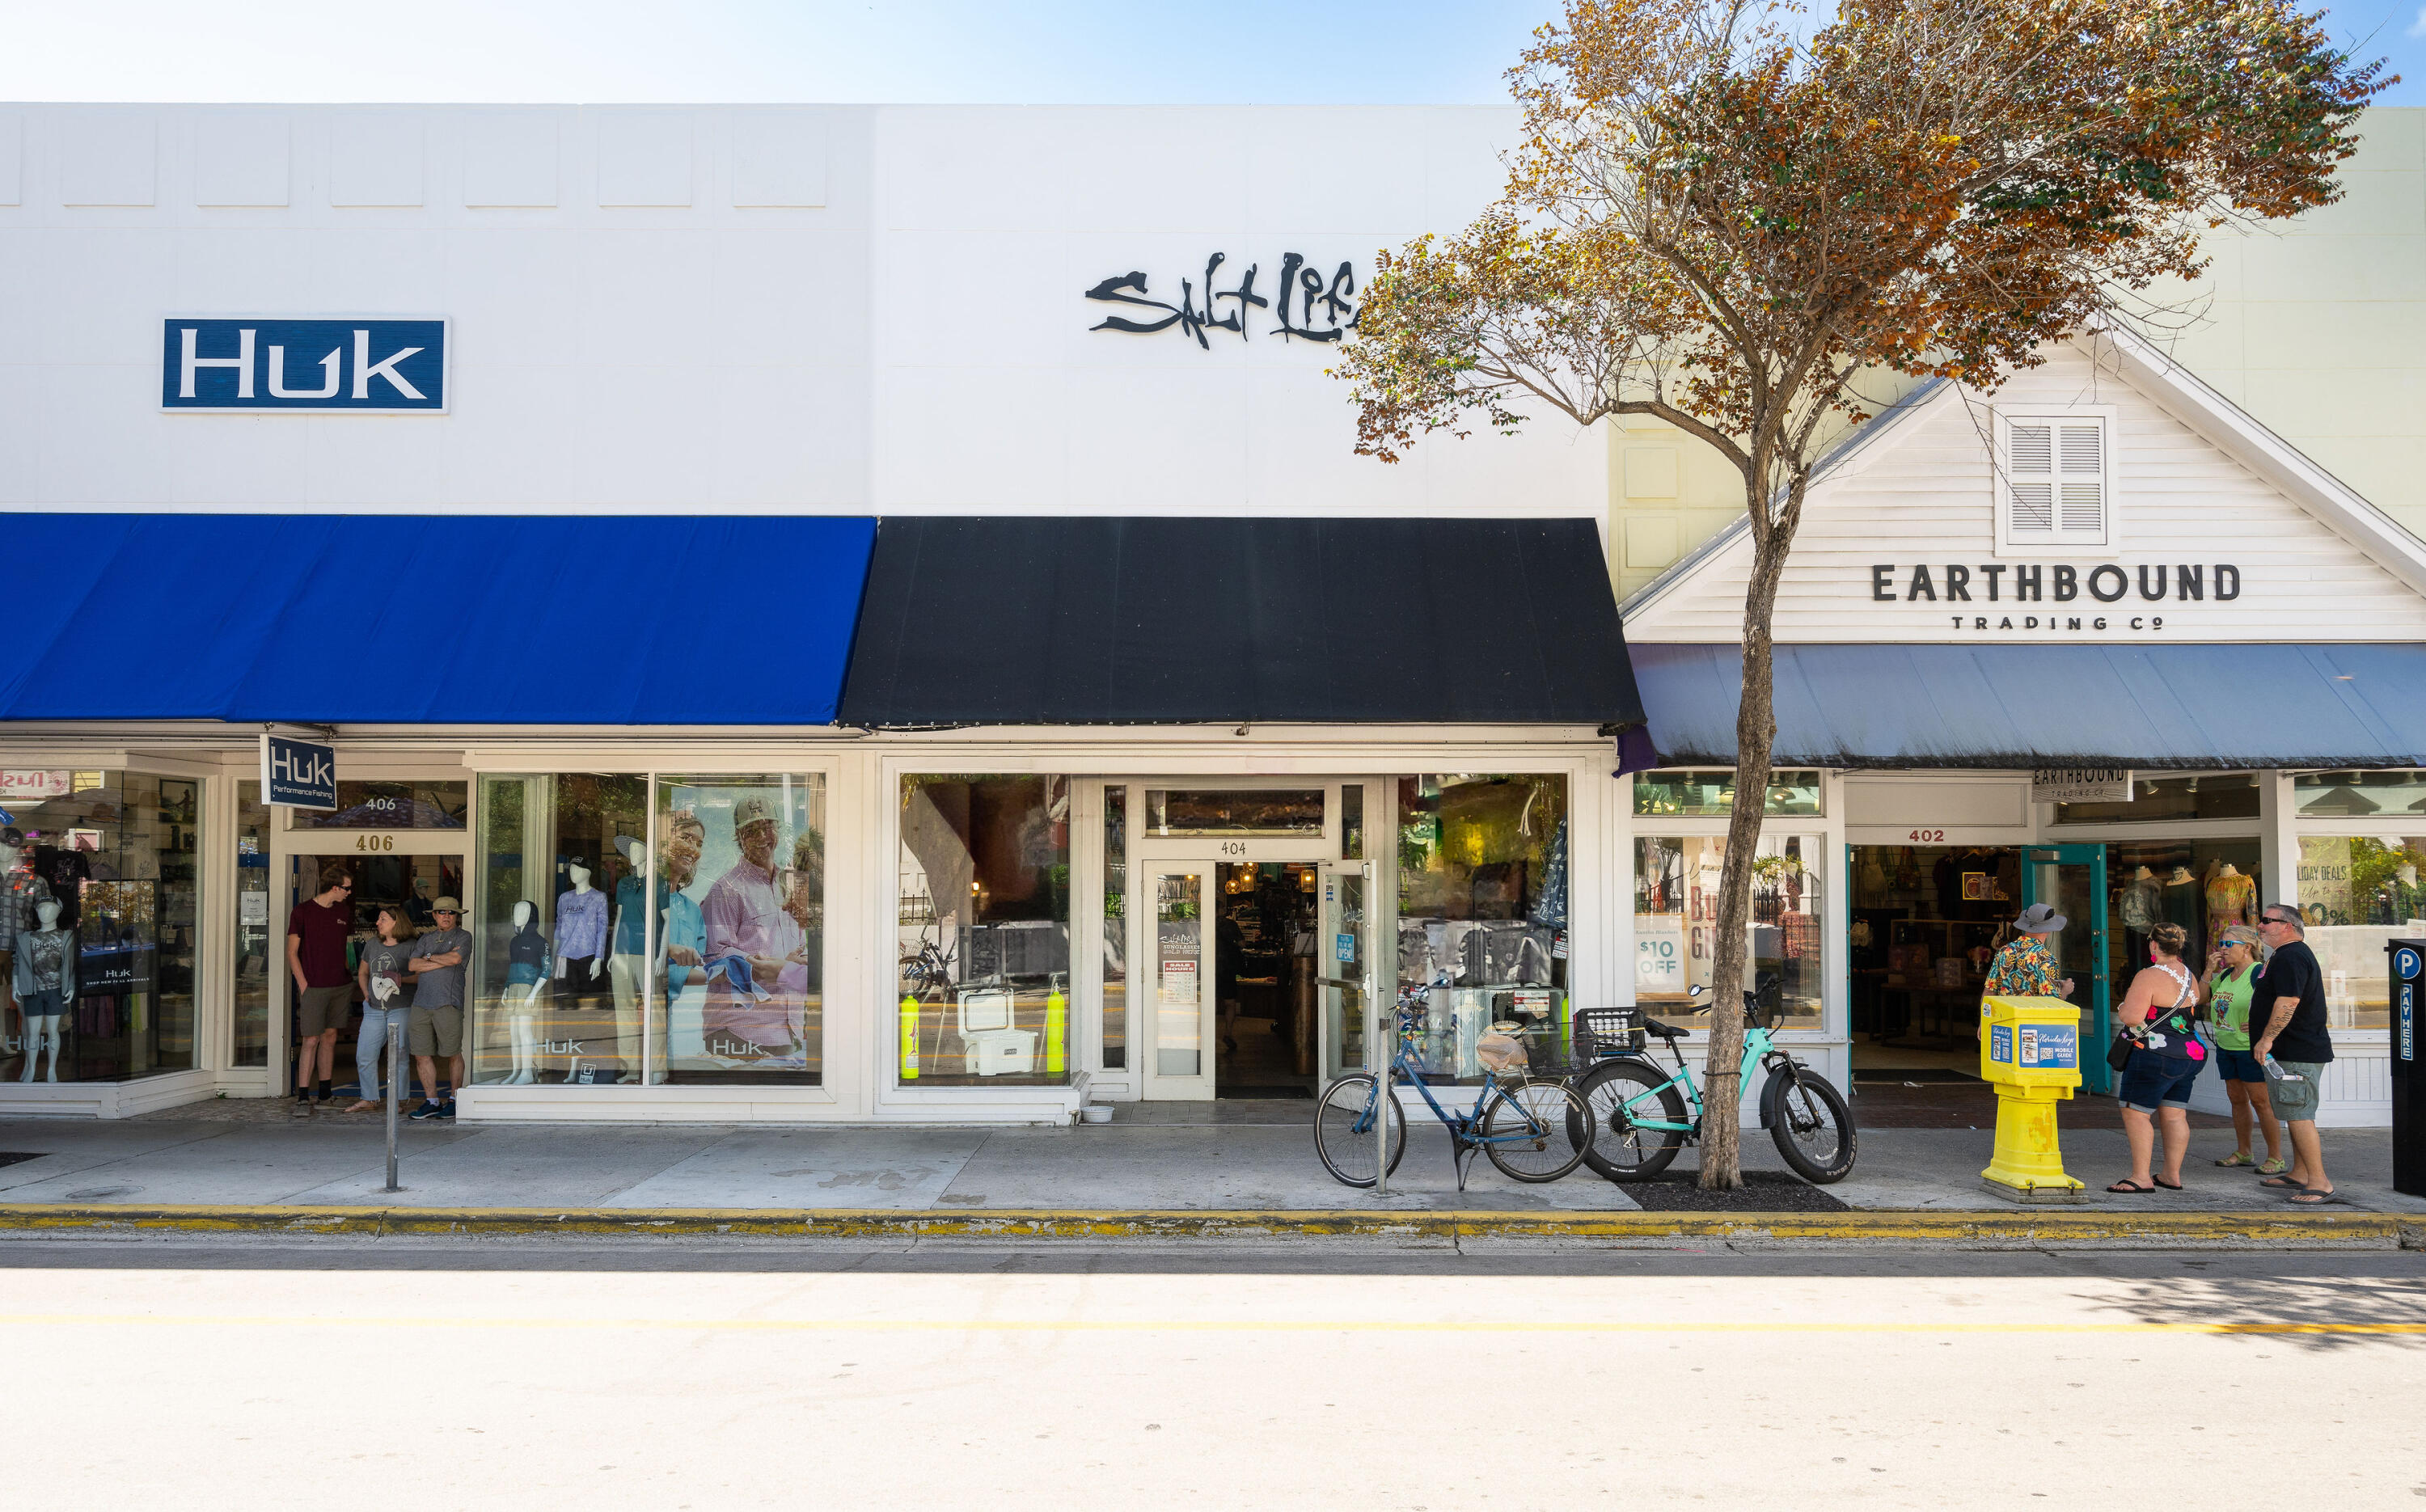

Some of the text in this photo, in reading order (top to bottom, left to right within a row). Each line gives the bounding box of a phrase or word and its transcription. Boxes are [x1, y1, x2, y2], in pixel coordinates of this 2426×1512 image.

[1872, 564, 2241, 602] EARTHBOUND
[1952, 616, 2107, 630] TRADING
[2034, 769, 2124, 785] EARTHBOUND
[273, 784, 332, 800] Performance Fishing
[2052, 789, 2090, 797] TRADING
[366, 798, 396, 811] 406
[356, 834, 394, 851] 406
[1909, 830, 1944, 842] 402
[1221, 842, 1246, 855] 404
[2321, 865, 2347, 881] DEALS
[1640, 940, 1674, 958] $10
[377, 961, 391, 973] 17
[1640, 960, 1676, 974] OFF
[2401, 953, 2414, 974] P
[2402, 986, 2411, 1057] PAY HERE
[2039, 1032, 2074, 1046] Florida Keys
